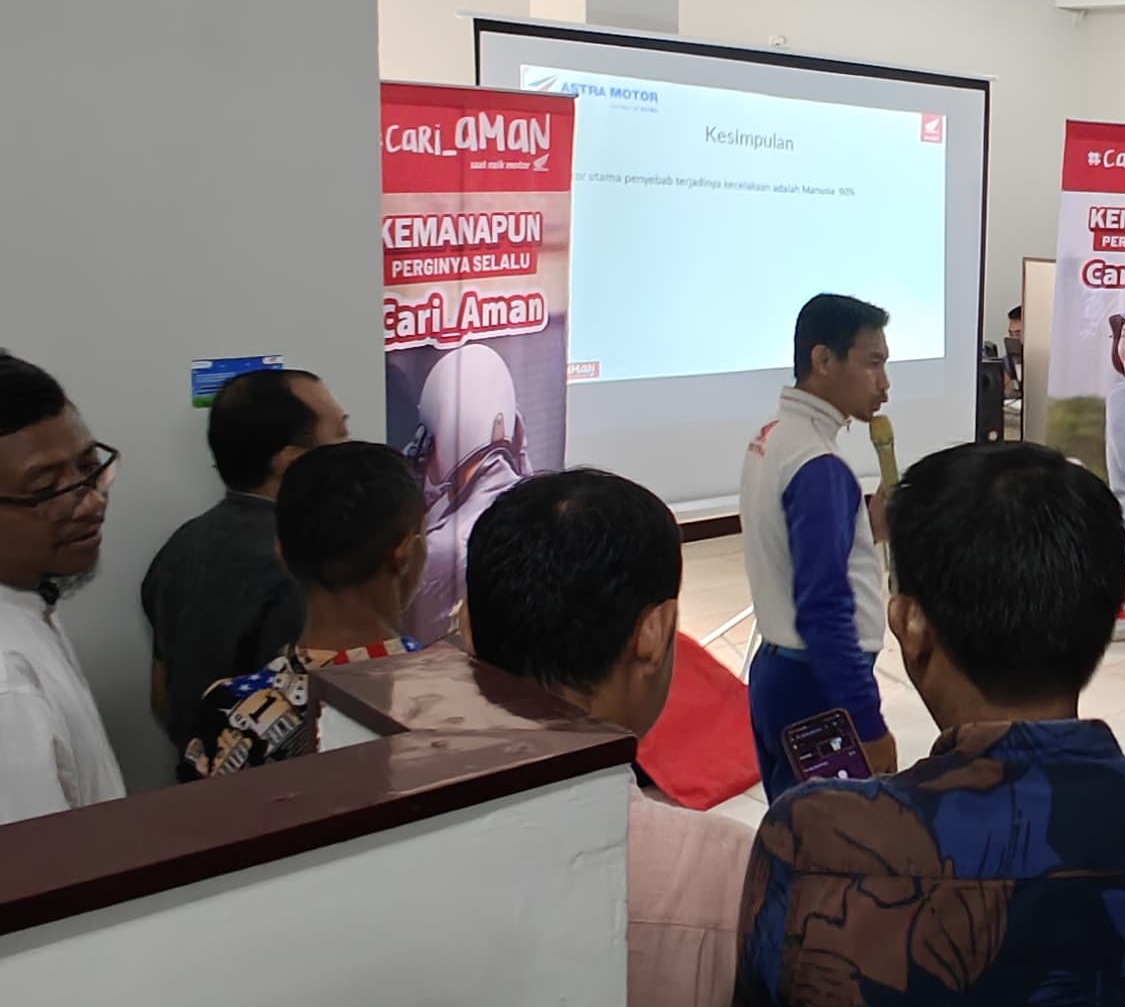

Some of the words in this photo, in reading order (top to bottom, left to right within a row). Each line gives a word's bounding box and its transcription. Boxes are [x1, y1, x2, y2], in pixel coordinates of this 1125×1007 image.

[561, 82, 606, 97] ASTRA
[610, 86, 658, 102] MOTOR
[705, 125, 794, 151] Kesimpulan
[588, 172, 622, 183] utama
[624, 174, 674, 187] penyebab
[675, 176, 722, 190] terjadinya
[381, 213, 541, 249] KEMANAPUN
[392, 255, 471, 278] PERGINYA
[473, 252, 530, 273] SELALU
